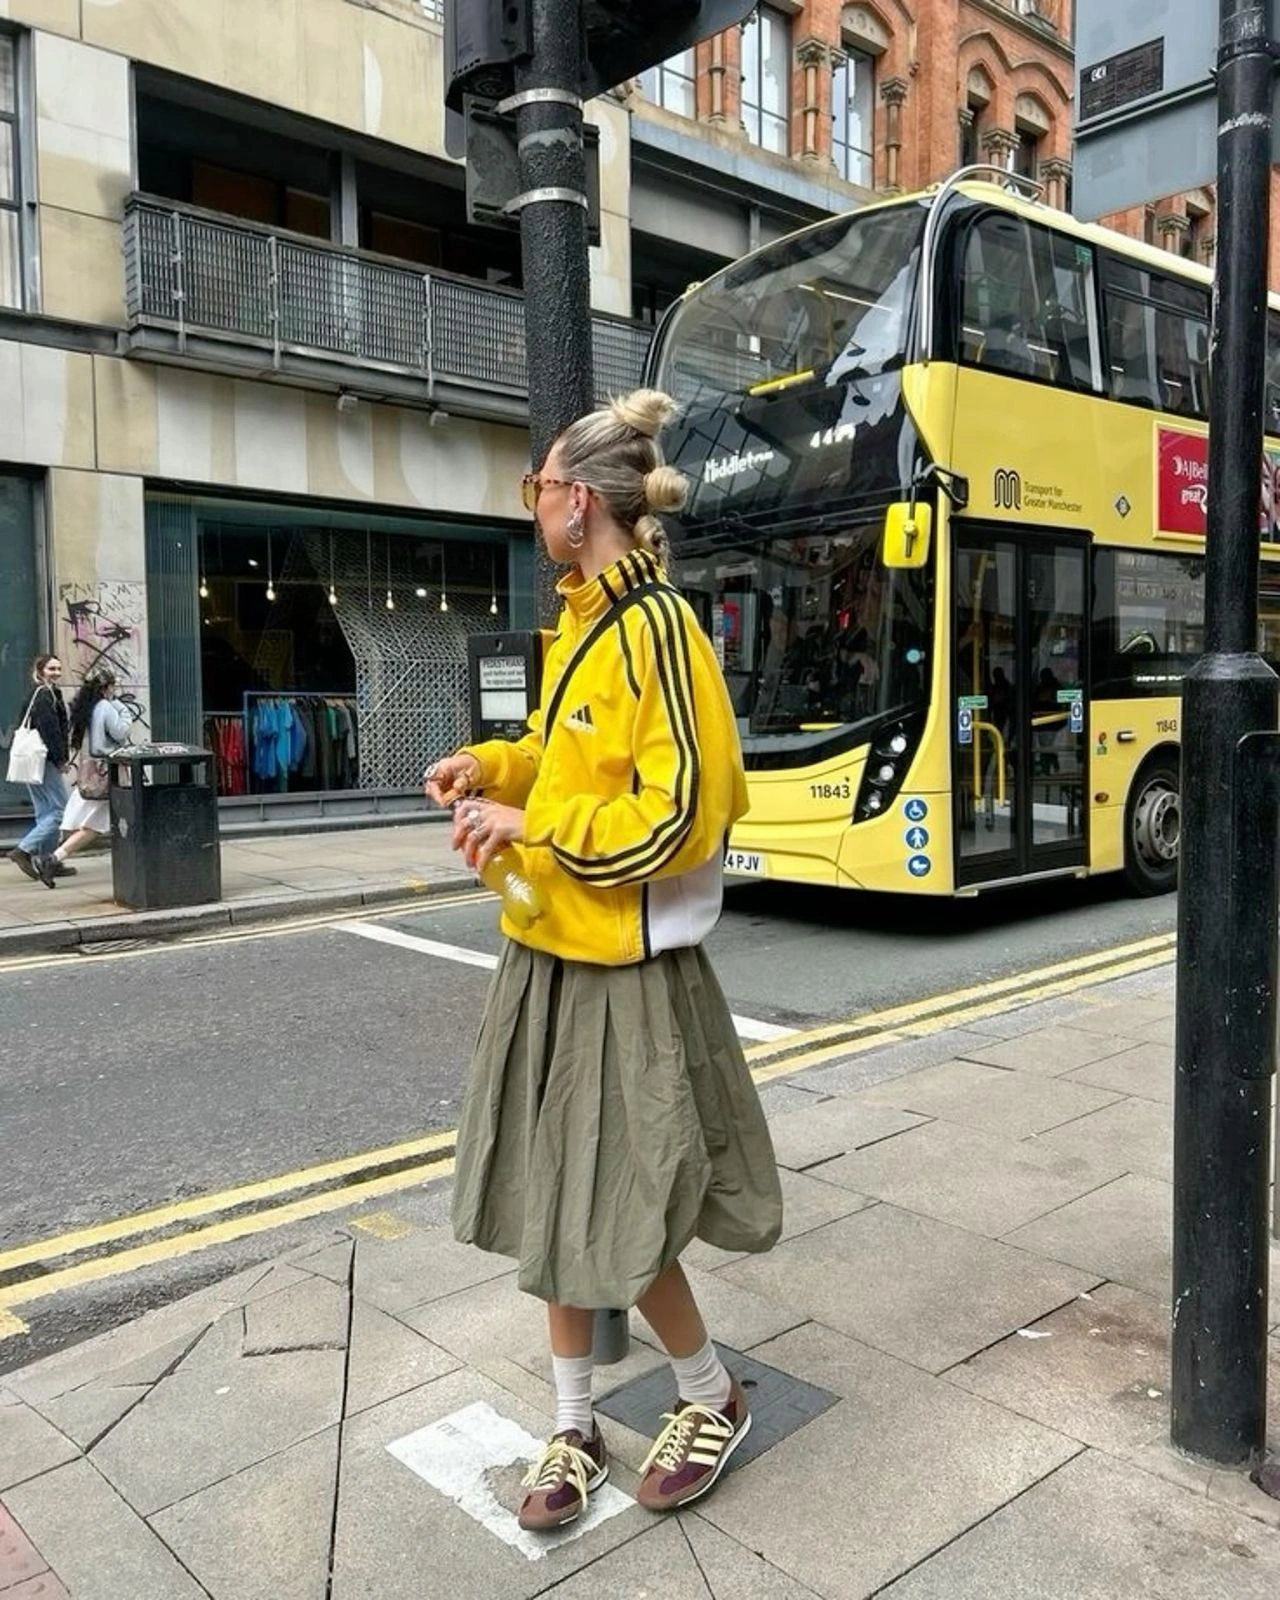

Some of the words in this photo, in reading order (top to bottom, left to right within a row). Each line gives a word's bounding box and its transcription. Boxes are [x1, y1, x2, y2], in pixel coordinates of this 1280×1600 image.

[1025, 481, 1053, 497] Transport
[1048, 499, 1083, 513] Manchester
[809, 785, 850, 799] 11843
[737, 854, 759, 871] PJV
